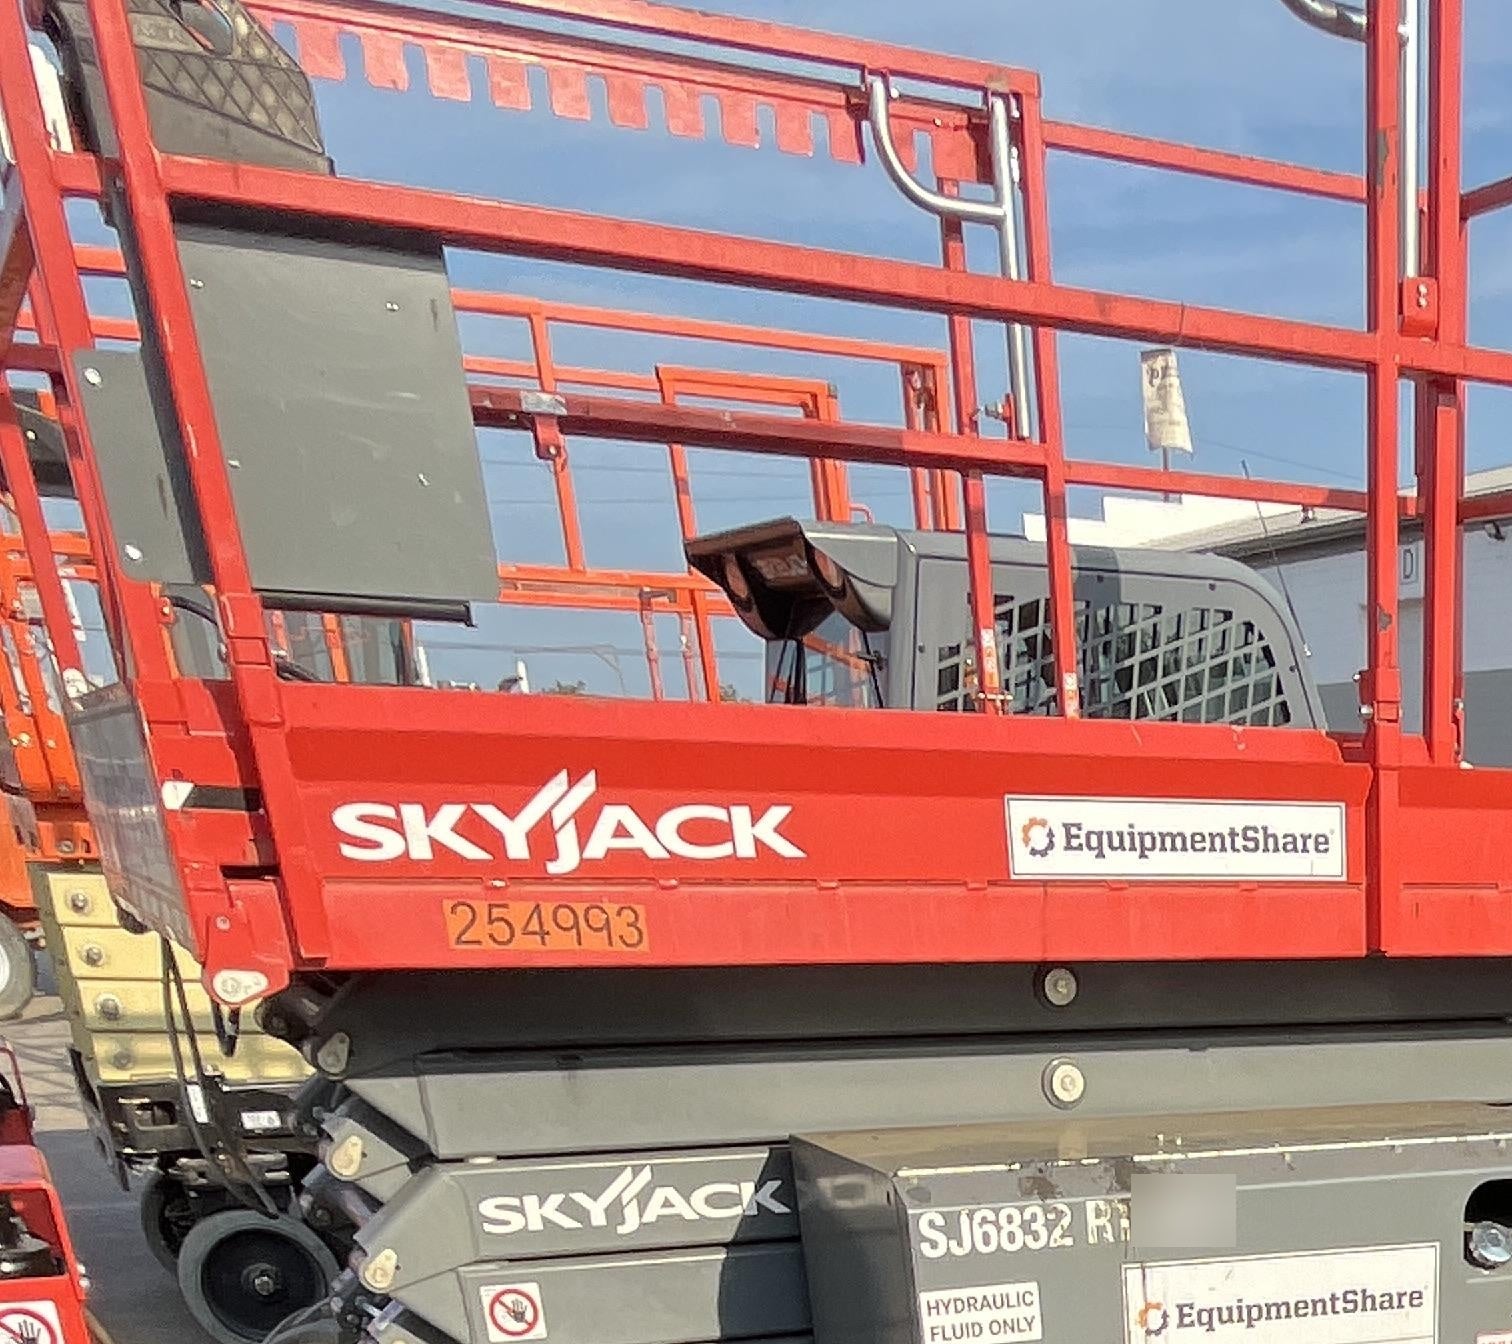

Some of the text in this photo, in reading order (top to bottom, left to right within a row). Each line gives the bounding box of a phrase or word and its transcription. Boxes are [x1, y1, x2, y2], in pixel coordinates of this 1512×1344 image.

[331, 768, 807, 875] SKYJACK
[1062, 822, 1330, 860] EquipmentShare
[449, 901, 645, 948] 254993
[478, 1164, 792, 1235] SKYJACK
[918, 1203, 1074, 1258] SJ6832
[926, 1290, 1035, 1317] HYDRAULIC
[1175, 1288, 1424, 1332] EquipmentShare
[929, 1316, 1036, 1343] FLUID ONLY
